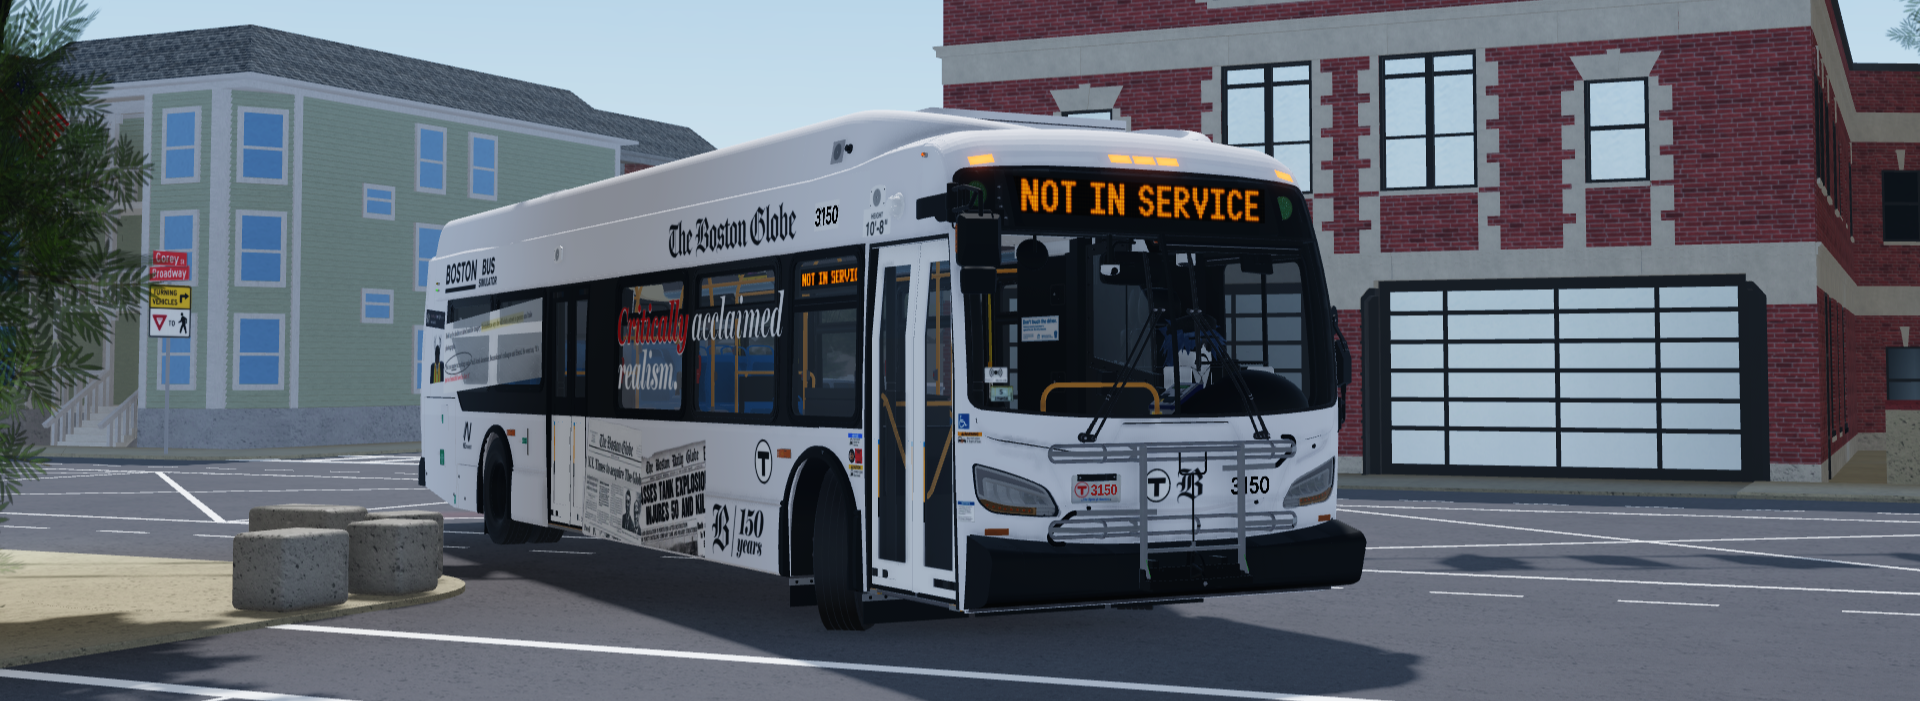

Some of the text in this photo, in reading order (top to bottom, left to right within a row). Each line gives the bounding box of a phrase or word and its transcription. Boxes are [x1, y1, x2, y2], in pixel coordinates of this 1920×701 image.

[1020, 178, 1261, 223] NOT IN SERVICE
[814, 204, 839, 227] 3150
[870, 211, 884, 220] HEIGHT
[668, 202, 797, 258] The Boston Globe
[155, 252, 179, 266] Corey
[445, 256, 496, 285] BOSTON BUS
[152, 268, 187, 281] Broadway
[478, 276, 498, 288] SIMULATOR
[801, 272, 816, 287] NOT
[818, 271, 829, 286] IN
[152, 298, 178, 306] VEHICLES
[153, 288, 178, 296] TURNING
[617, 289, 786, 356] Critically acclaimed
[617, 349, 678, 391] realism.
[599, 433, 607, 448] The
[607, 435, 621, 453] Boston
[621, 440, 634, 457] Globe
[645, 461, 654, 475] The
[655, 458, 670, 472] Boston
[685, 447, 699, 464] Globe
[658, 478, 674, 501] TANK
[1090, 484, 1118, 496] 3150
[646, 501, 670, 526] INJURES
[670, 499, 679, 521] 50
[681, 496, 694, 518] AND
[739, 508, 764, 538] 150
[736, 537, 763, 558] years
